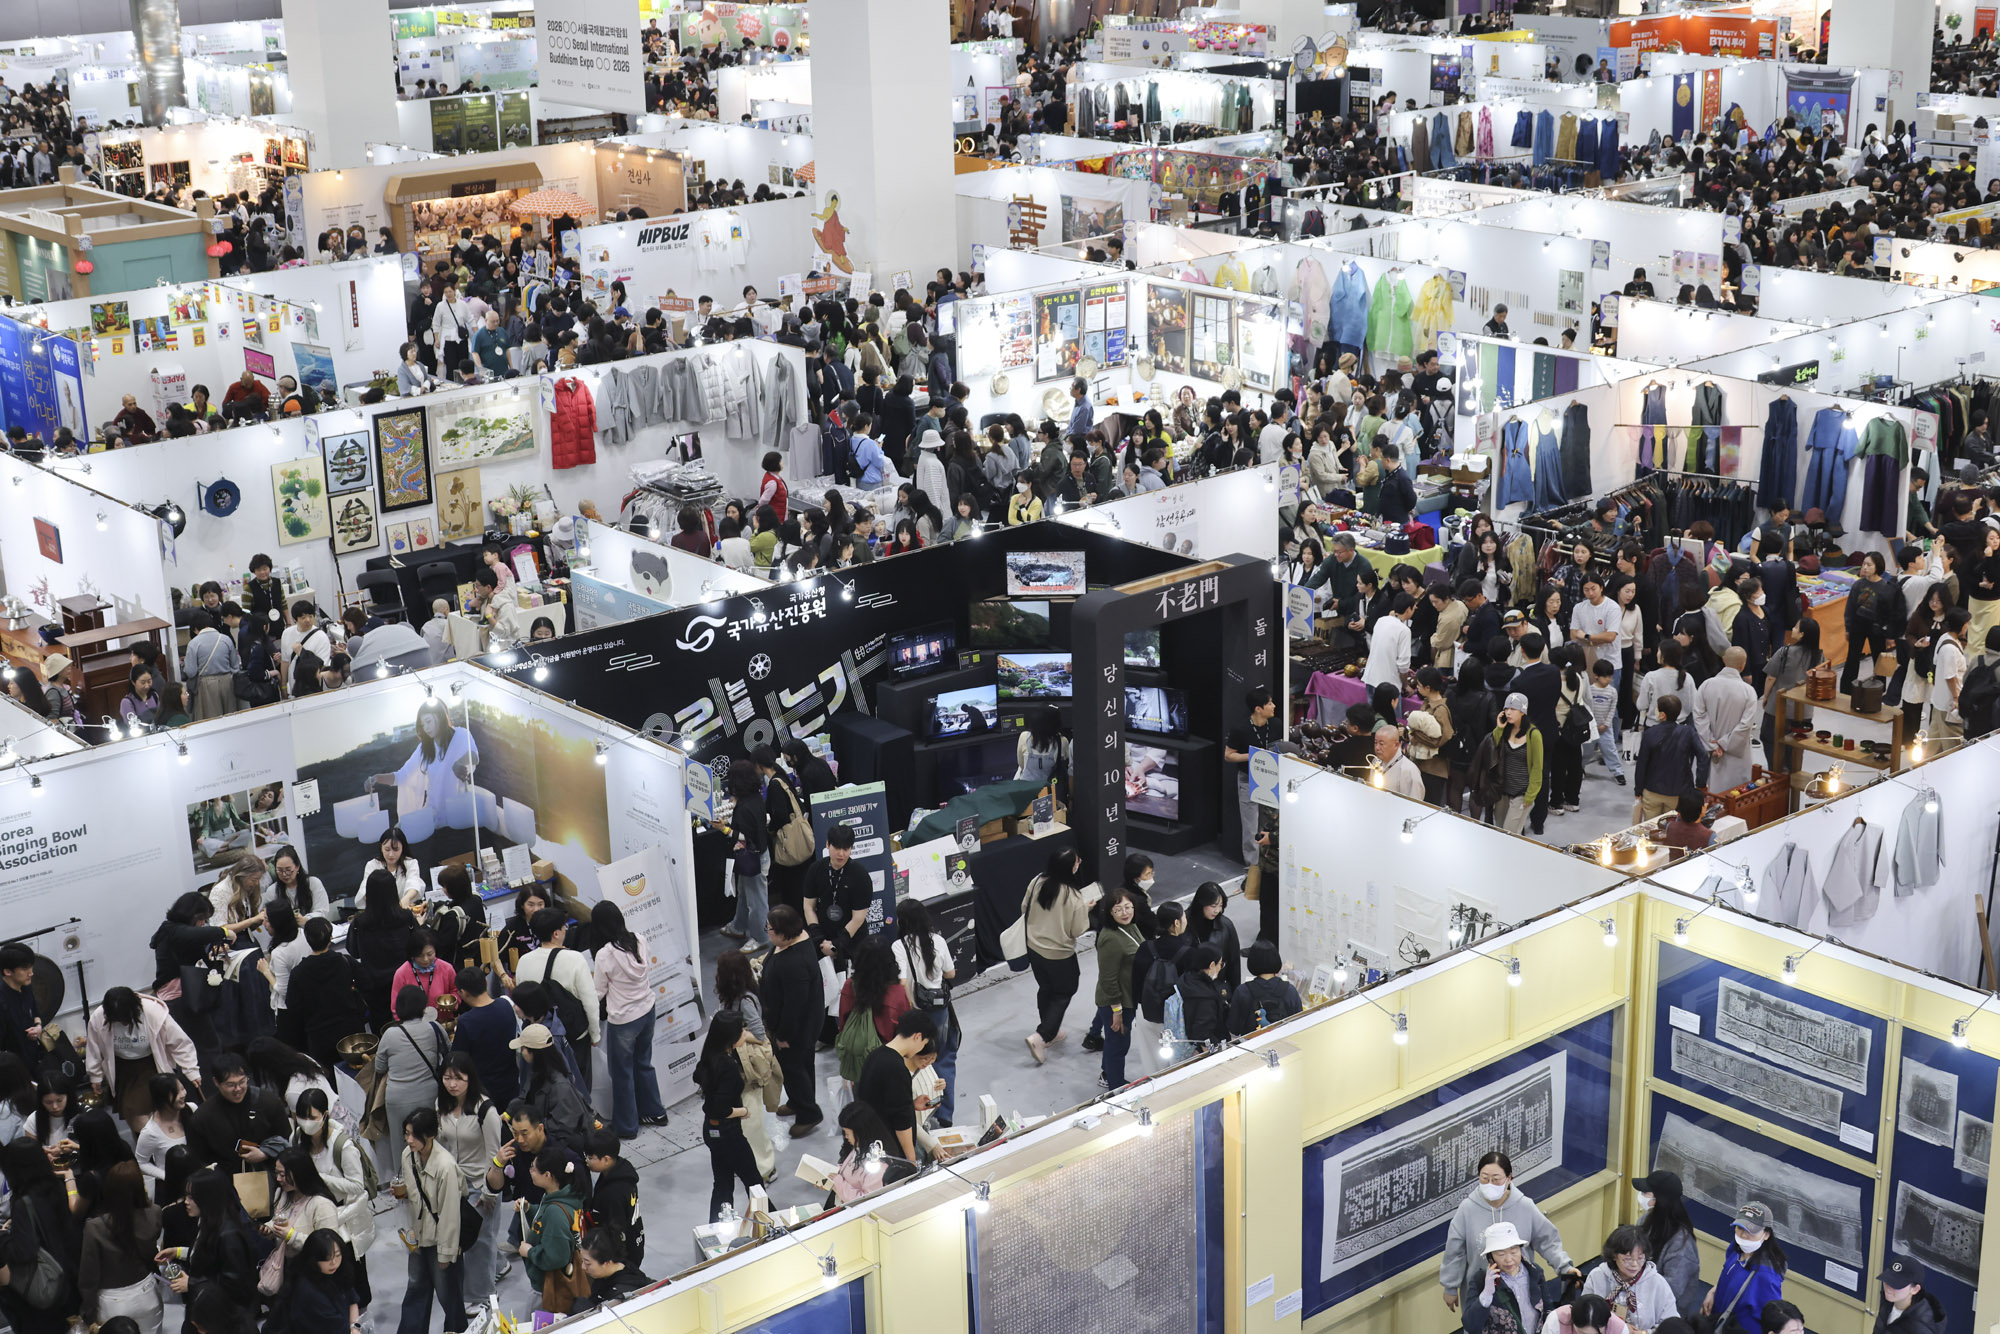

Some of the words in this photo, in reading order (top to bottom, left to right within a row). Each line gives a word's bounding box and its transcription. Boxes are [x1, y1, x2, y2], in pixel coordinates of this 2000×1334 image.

[547, 20, 562, 32] 2026
[572, 39, 589, 51] Seoul
[590, 41, 629, 56] International
[1709, 37, 1730, 47] BTN
[1731, 38, 1746, 48] 투어
[549, 52, 578, 66] Buddhism
[580, 56, 594, 70] Expo
[613, 60, 630, 73] 2026
[628, 168, 651, 186] 견심사
[637, 223, 690, 247] HIPBUZ
[789, 585, 826, 603] 국가유산청
[1155, 575, 1219, 619] 不老門
[727, 597, 827, 641] 국가유산진흥원
[1255, 617, 1268, 690] 돌려
[1103, 663, 1118, 749] 당신의
[0, 837, 48, 856] inging
[52, 823, 88, 843] Bowl
[622, 872, 645, 886] KOSBA
